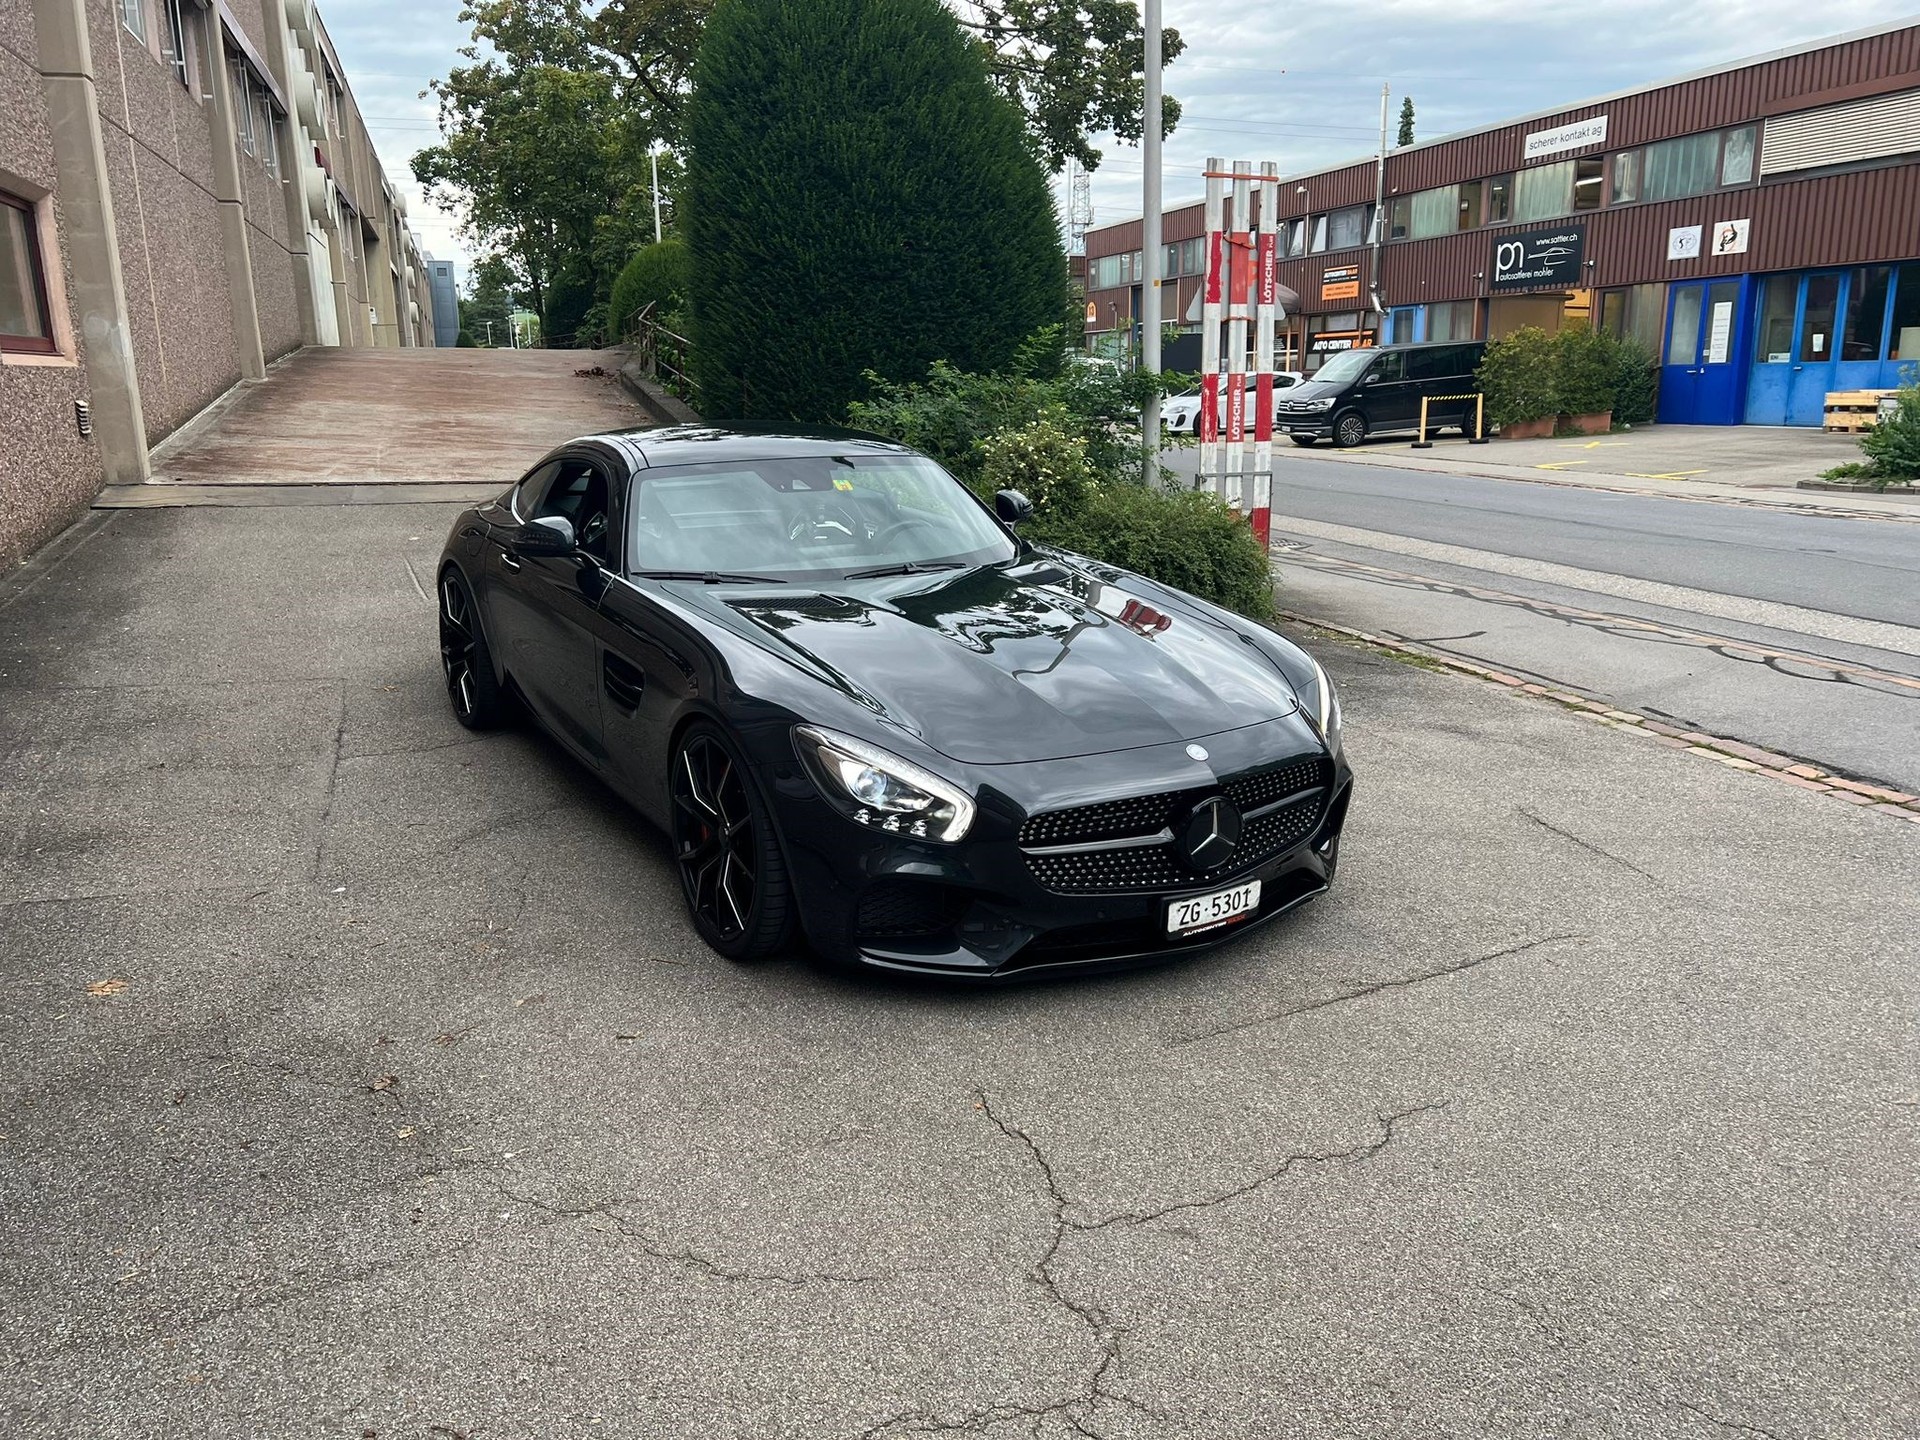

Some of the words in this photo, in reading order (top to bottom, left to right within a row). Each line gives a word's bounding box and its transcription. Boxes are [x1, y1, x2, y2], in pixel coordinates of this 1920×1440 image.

[1529, 137, 1558, 151] scherer
[1560, 127, 1590, 143] kontakt
[1591, 126, 1602, 136] ag
[1533, 266, 1554, 277] mohler
[1328, 339, 1352, 350] CENTER
